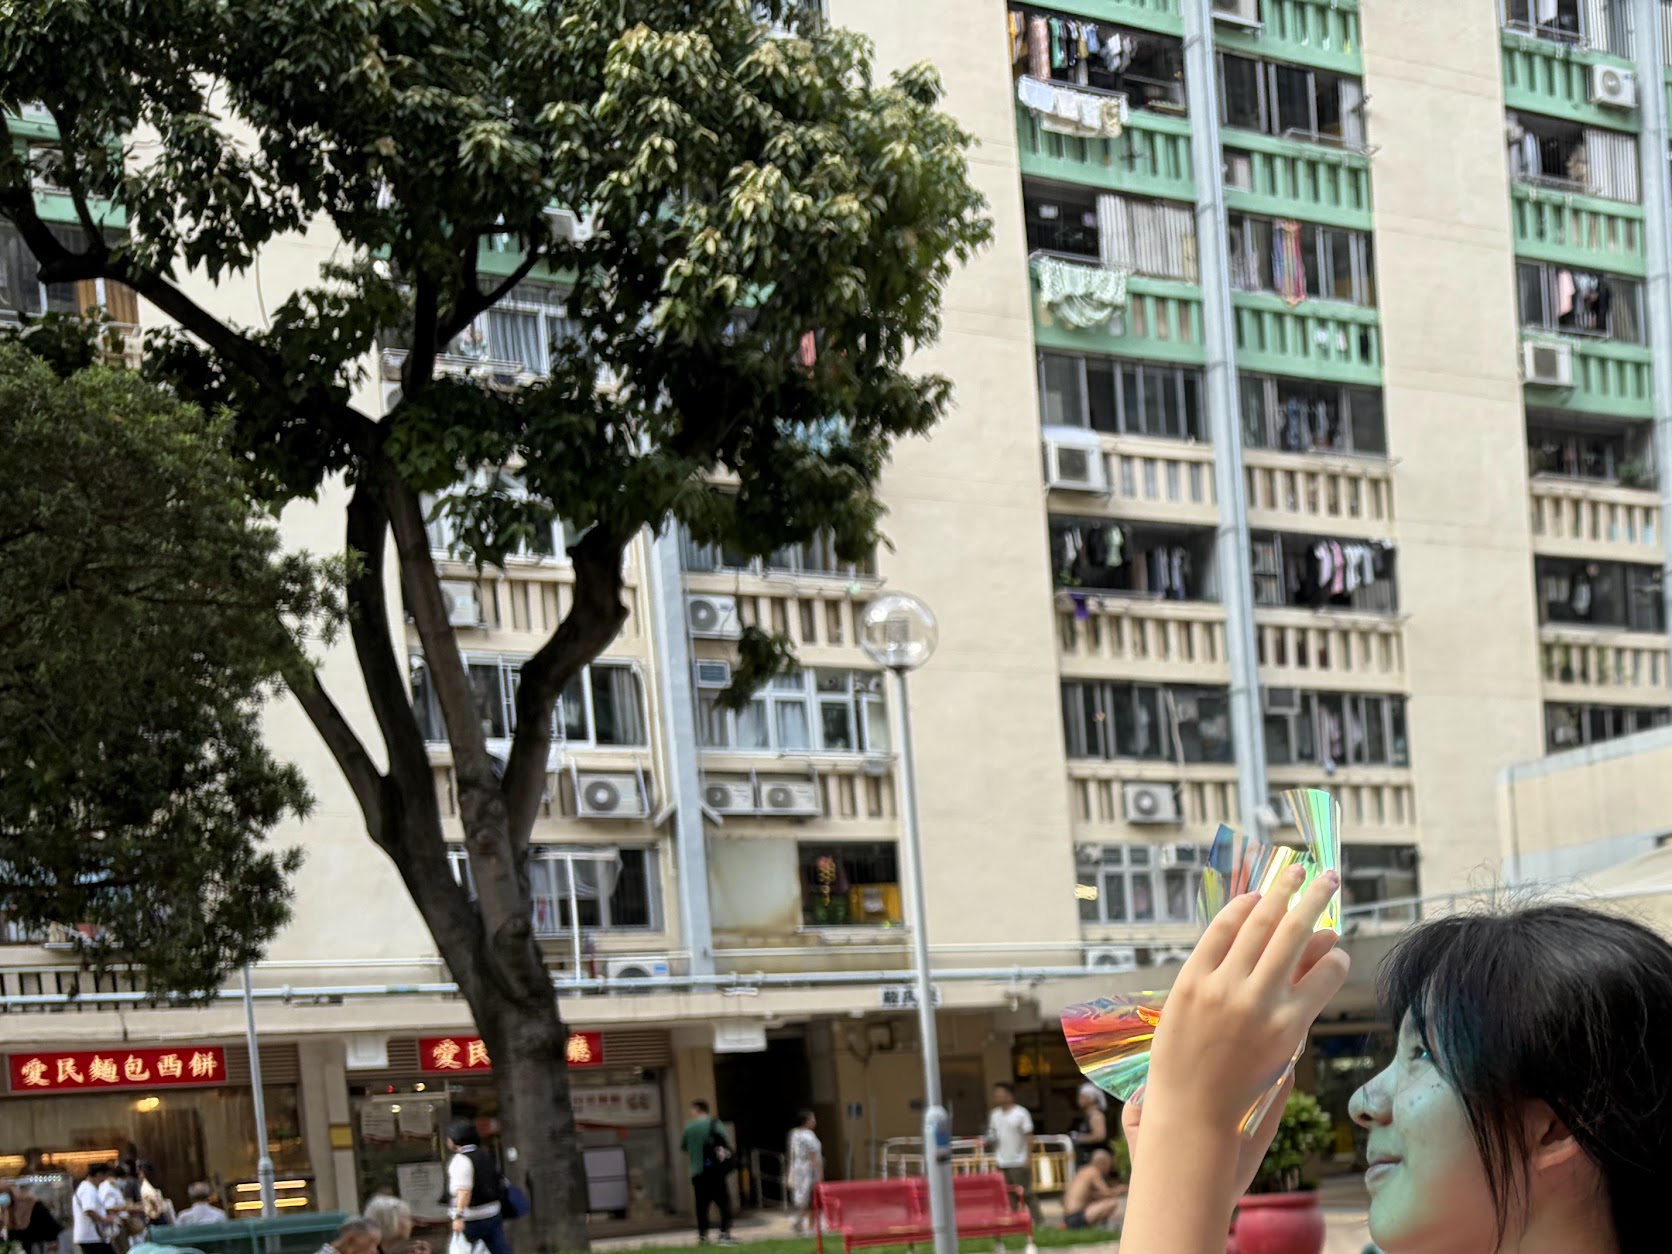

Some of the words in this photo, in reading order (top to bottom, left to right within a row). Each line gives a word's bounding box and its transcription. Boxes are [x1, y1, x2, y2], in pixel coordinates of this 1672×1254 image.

[21, 1051, 218, 1087] 愛民麵包西餅
